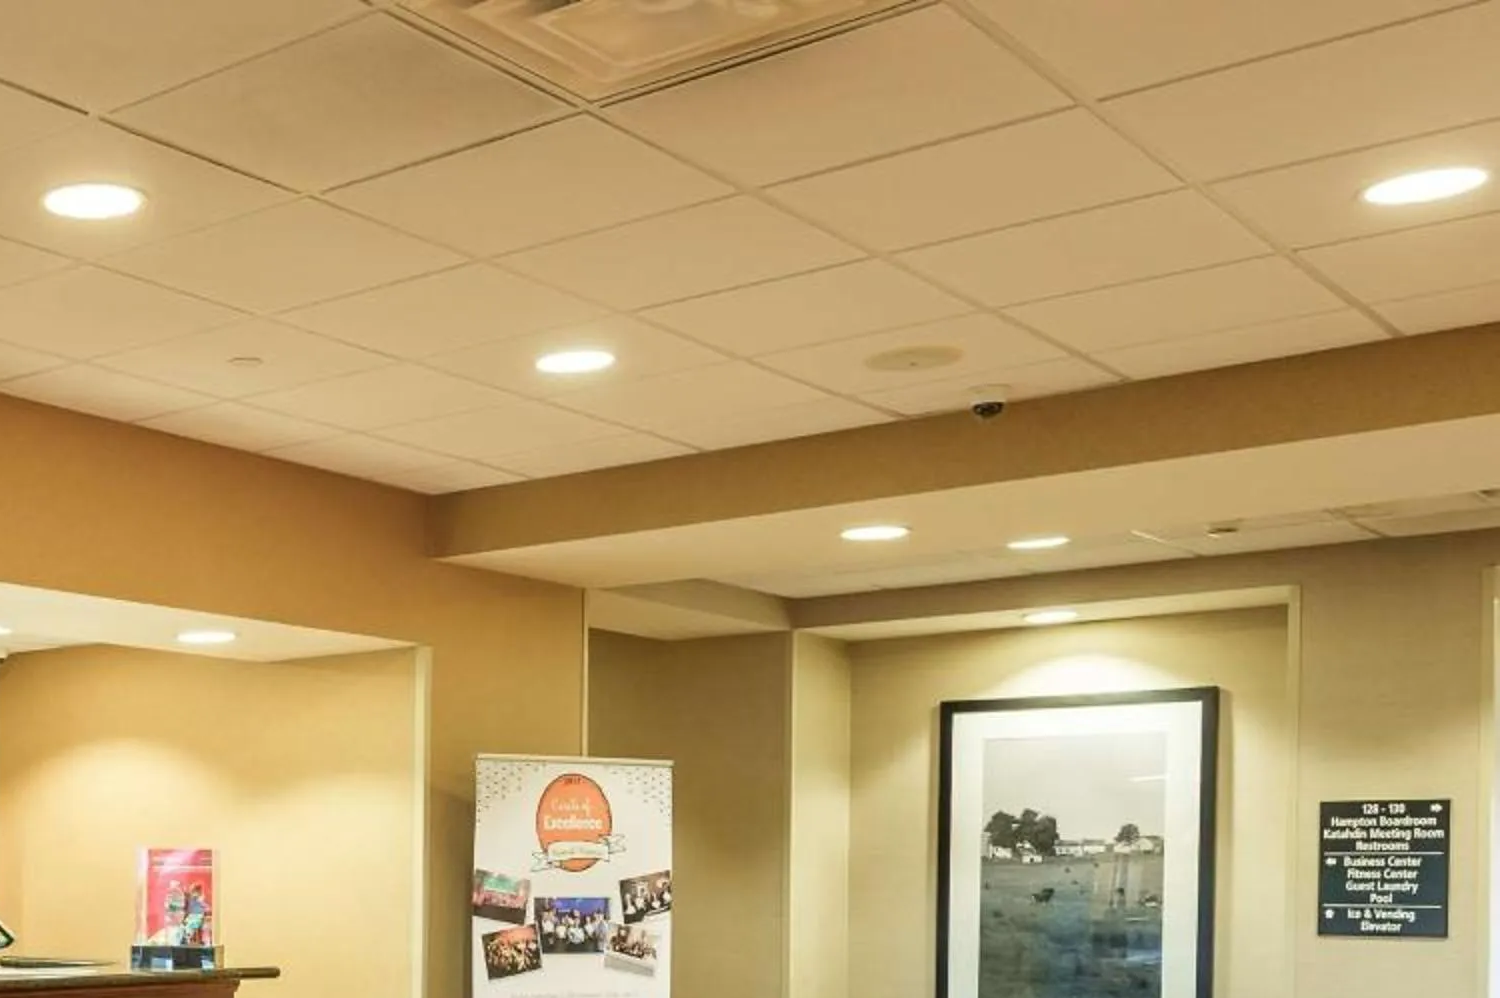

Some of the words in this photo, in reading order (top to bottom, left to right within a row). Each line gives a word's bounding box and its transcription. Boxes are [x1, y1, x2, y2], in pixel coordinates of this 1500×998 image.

[1362, 803, 1379, 814] 128
[1331, 816, 1377, 828] Hampton
[1379, 815, 1437, 827] Boardroom
[1323, 829, 1367, 839] Katahdin
[1369, 829, 1412, 841] Meeting
[1413, 828, 1445, 838] Room
[1355, 841, 1409, 851] Restrooms
[1343, 856, 1386, 867] Business
[1387, 856, 1422, 867] Center
[1347, 868, 1381, 879] Fitness
[1383, 868, 1418, 879] Center
[1345, 881, 1375, 891] Guest
[1377, 881, 1419, 894] Laundry
[1369, 893, 1393, 904] Pool
[1347, 909, 1361, 919] Ice
[1363, 909, 1372, 919] &
[1373, 909, 1416, 922] Vending
[1360, 921, 1402, 932] Elevator
